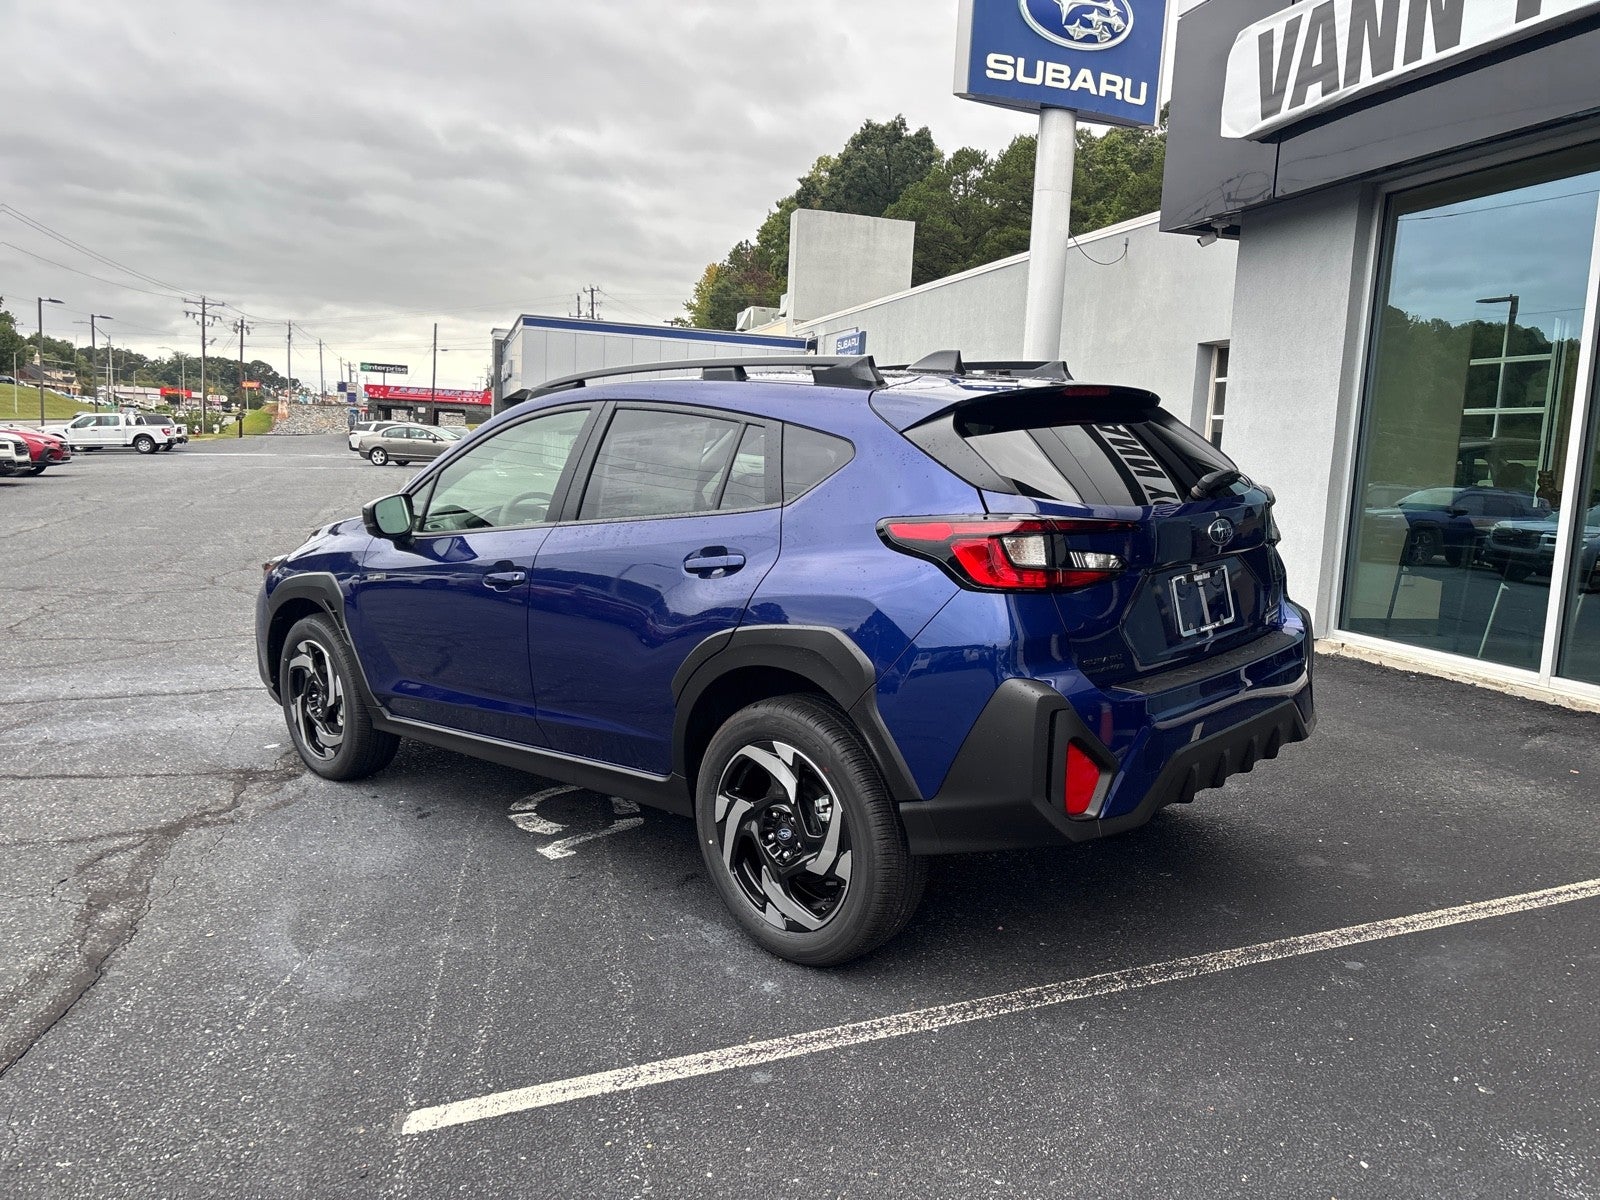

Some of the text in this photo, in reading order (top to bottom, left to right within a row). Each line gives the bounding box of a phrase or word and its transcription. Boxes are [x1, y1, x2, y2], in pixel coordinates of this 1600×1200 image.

[1258, 0, 1464, 121] VANN
[986, 53, 1147, 106] SUBARU
[837, 337, 860, 350] SUBARU
[361, 364, 407, 373] enterprise
